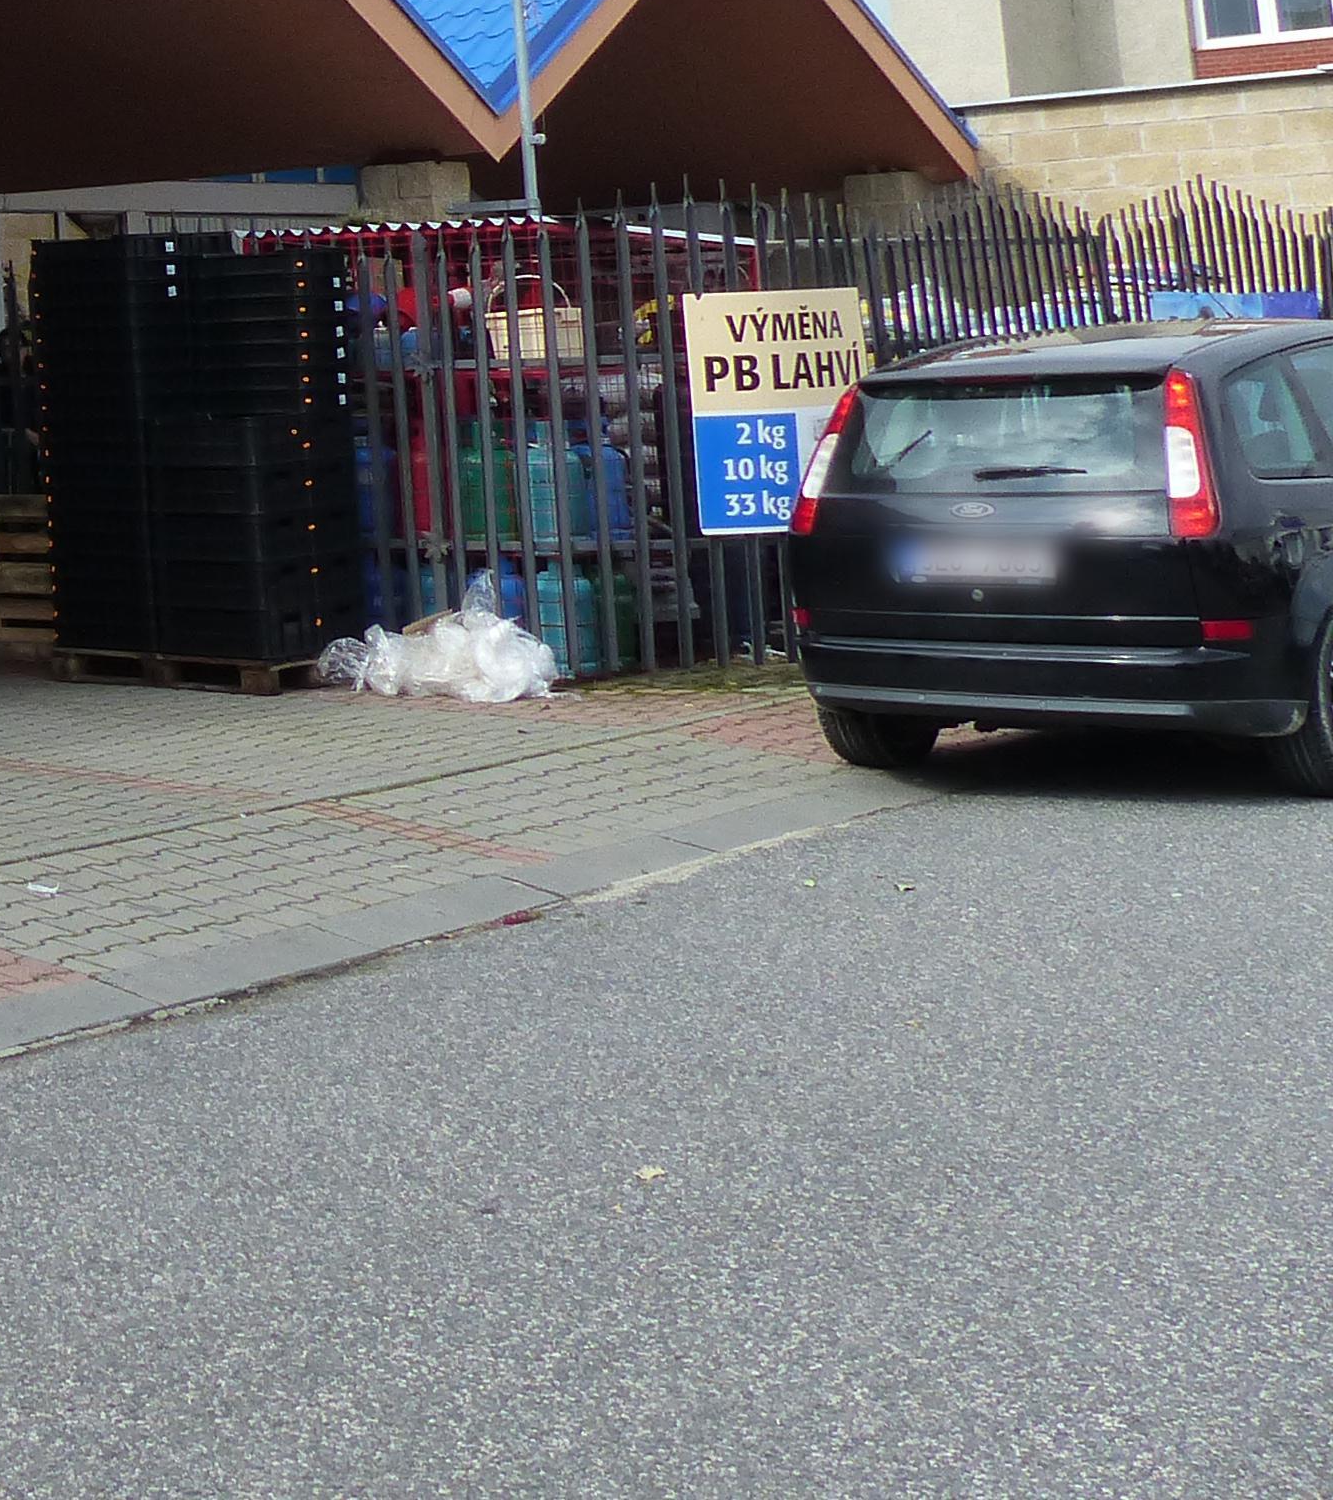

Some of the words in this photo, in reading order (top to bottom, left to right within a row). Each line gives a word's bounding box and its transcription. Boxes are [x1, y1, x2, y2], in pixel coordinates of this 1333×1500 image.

[724, 305, 844, 343] VÝMĚNA
[704, 355, 761, 392] PB
[771, 341, 861, 390] LAHVÍ
[735, 421, 753, 441] 2
[757, 419, 787, 450] kg
[723, 458, 755, 481] 10
[760, 455, 789, 485] kg
[725, 494, 757, 516] 33
[763, 490, 792, 521] kg
